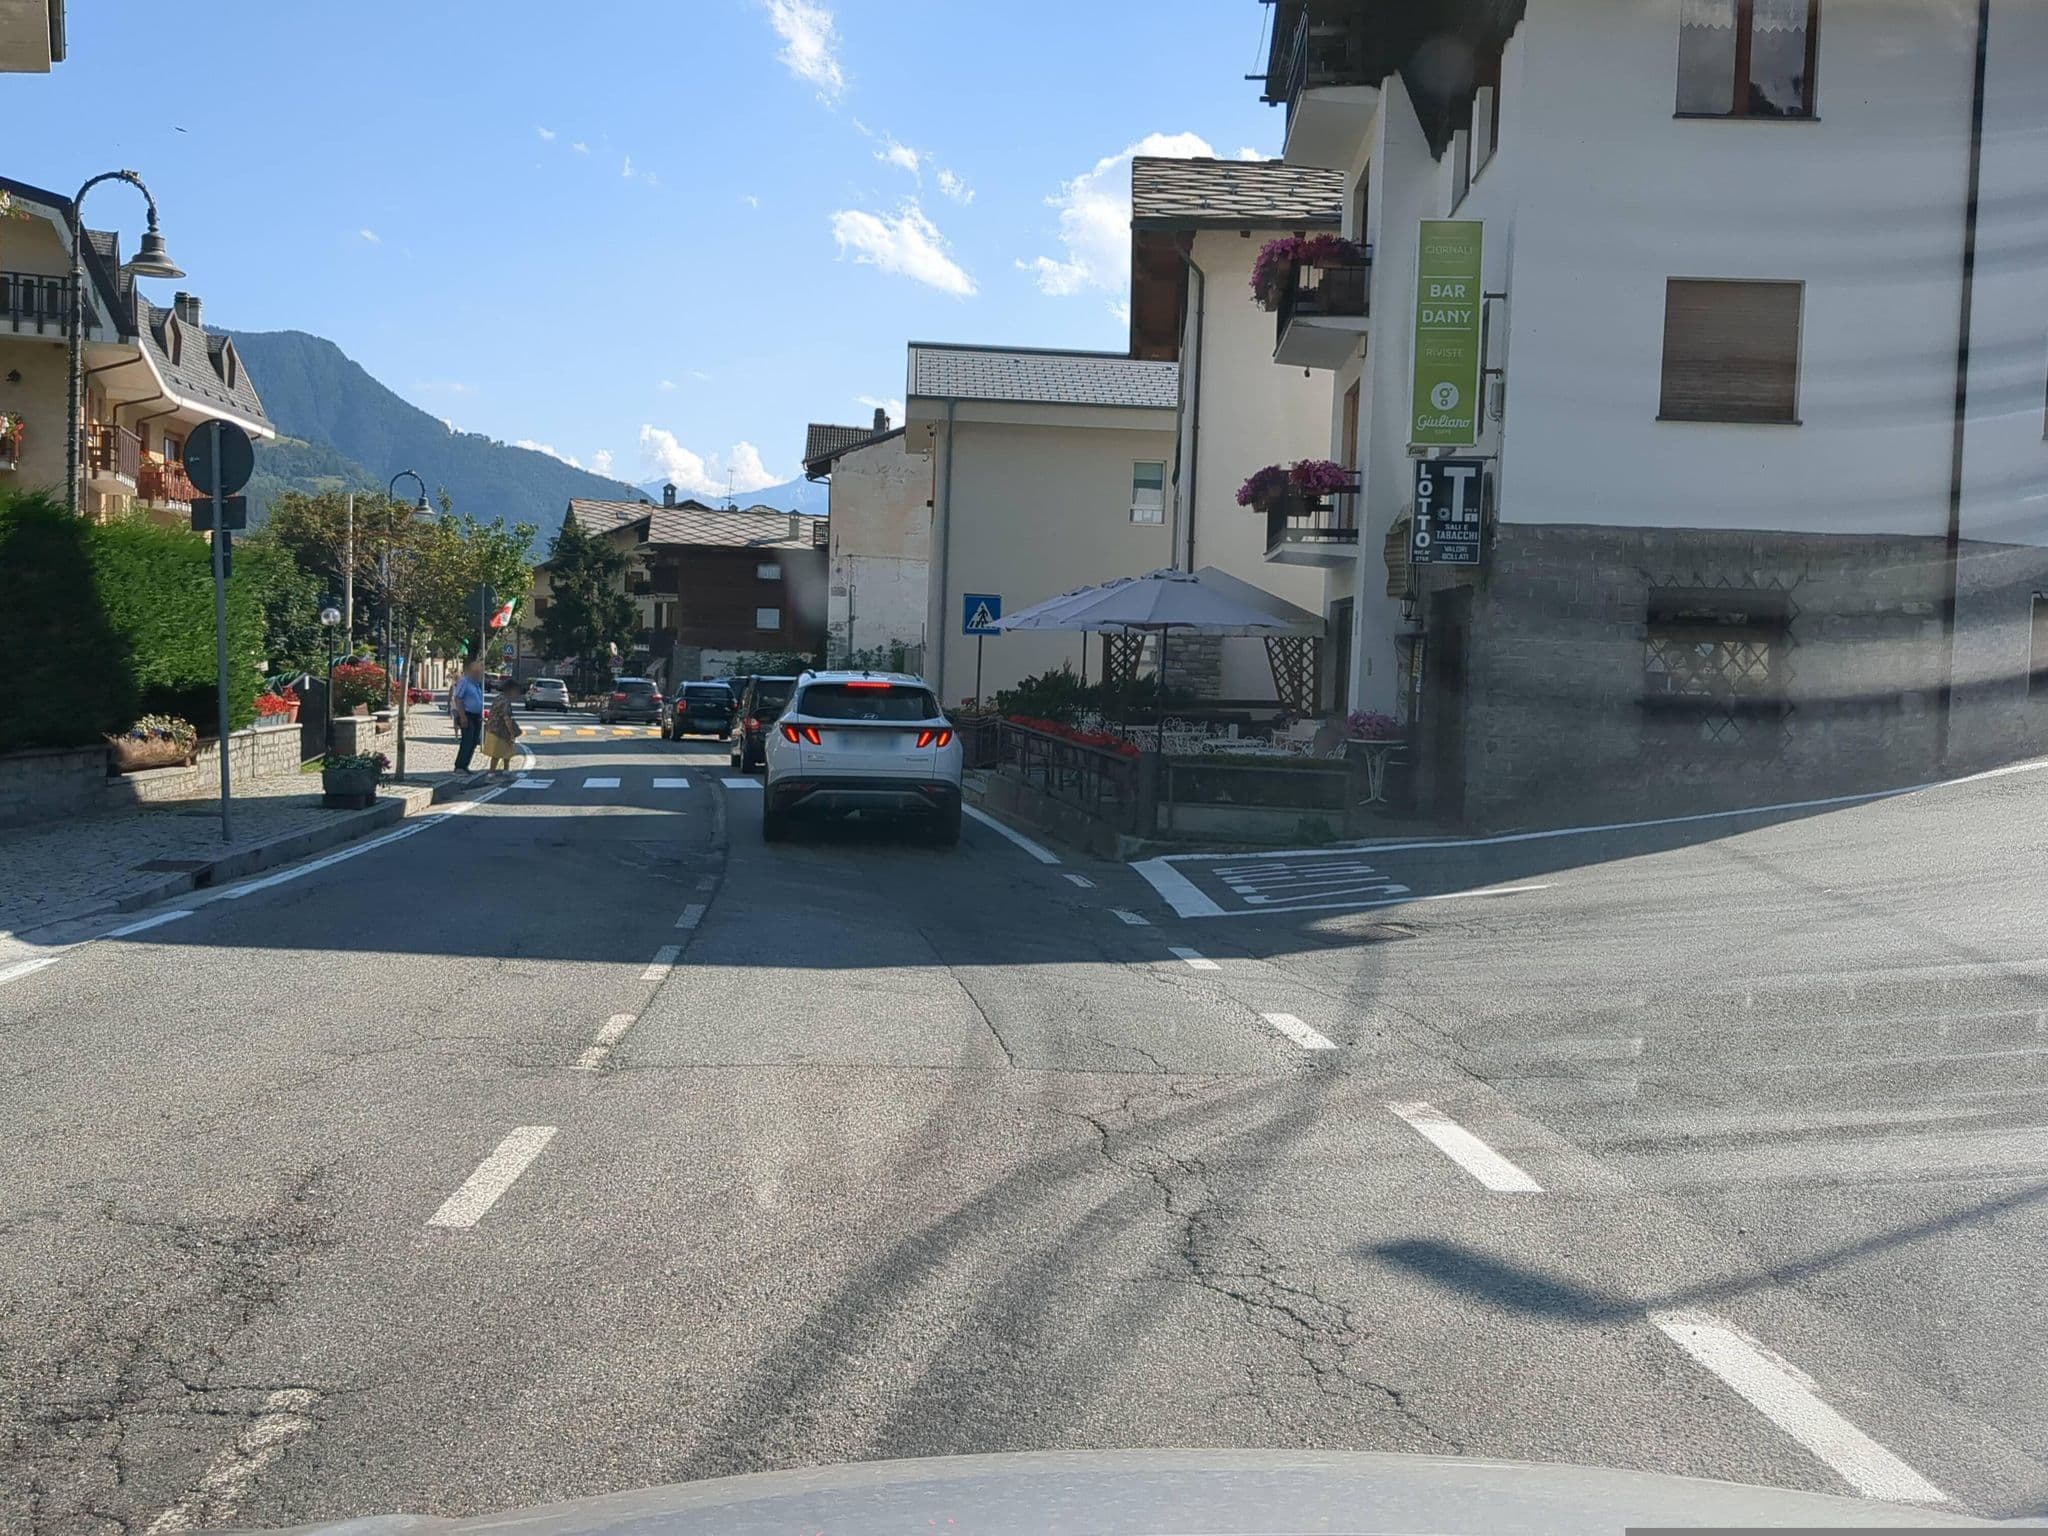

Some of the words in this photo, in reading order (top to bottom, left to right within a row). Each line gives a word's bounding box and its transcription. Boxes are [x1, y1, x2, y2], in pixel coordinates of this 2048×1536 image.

[1430, 284, 1465, 298] BAR
[1422, 309, 1472, 324] DANY
[1416, 414, 1472, 431] Giuliano
[1443, 466, 1476, 522] T
[1415, 463, 1433, 548] LOTTO
[1444, 523, 1462, 531] SALI
[1463, 523, 1469, 531] E
[1436, 530, 1478, 541] TABACCHI
